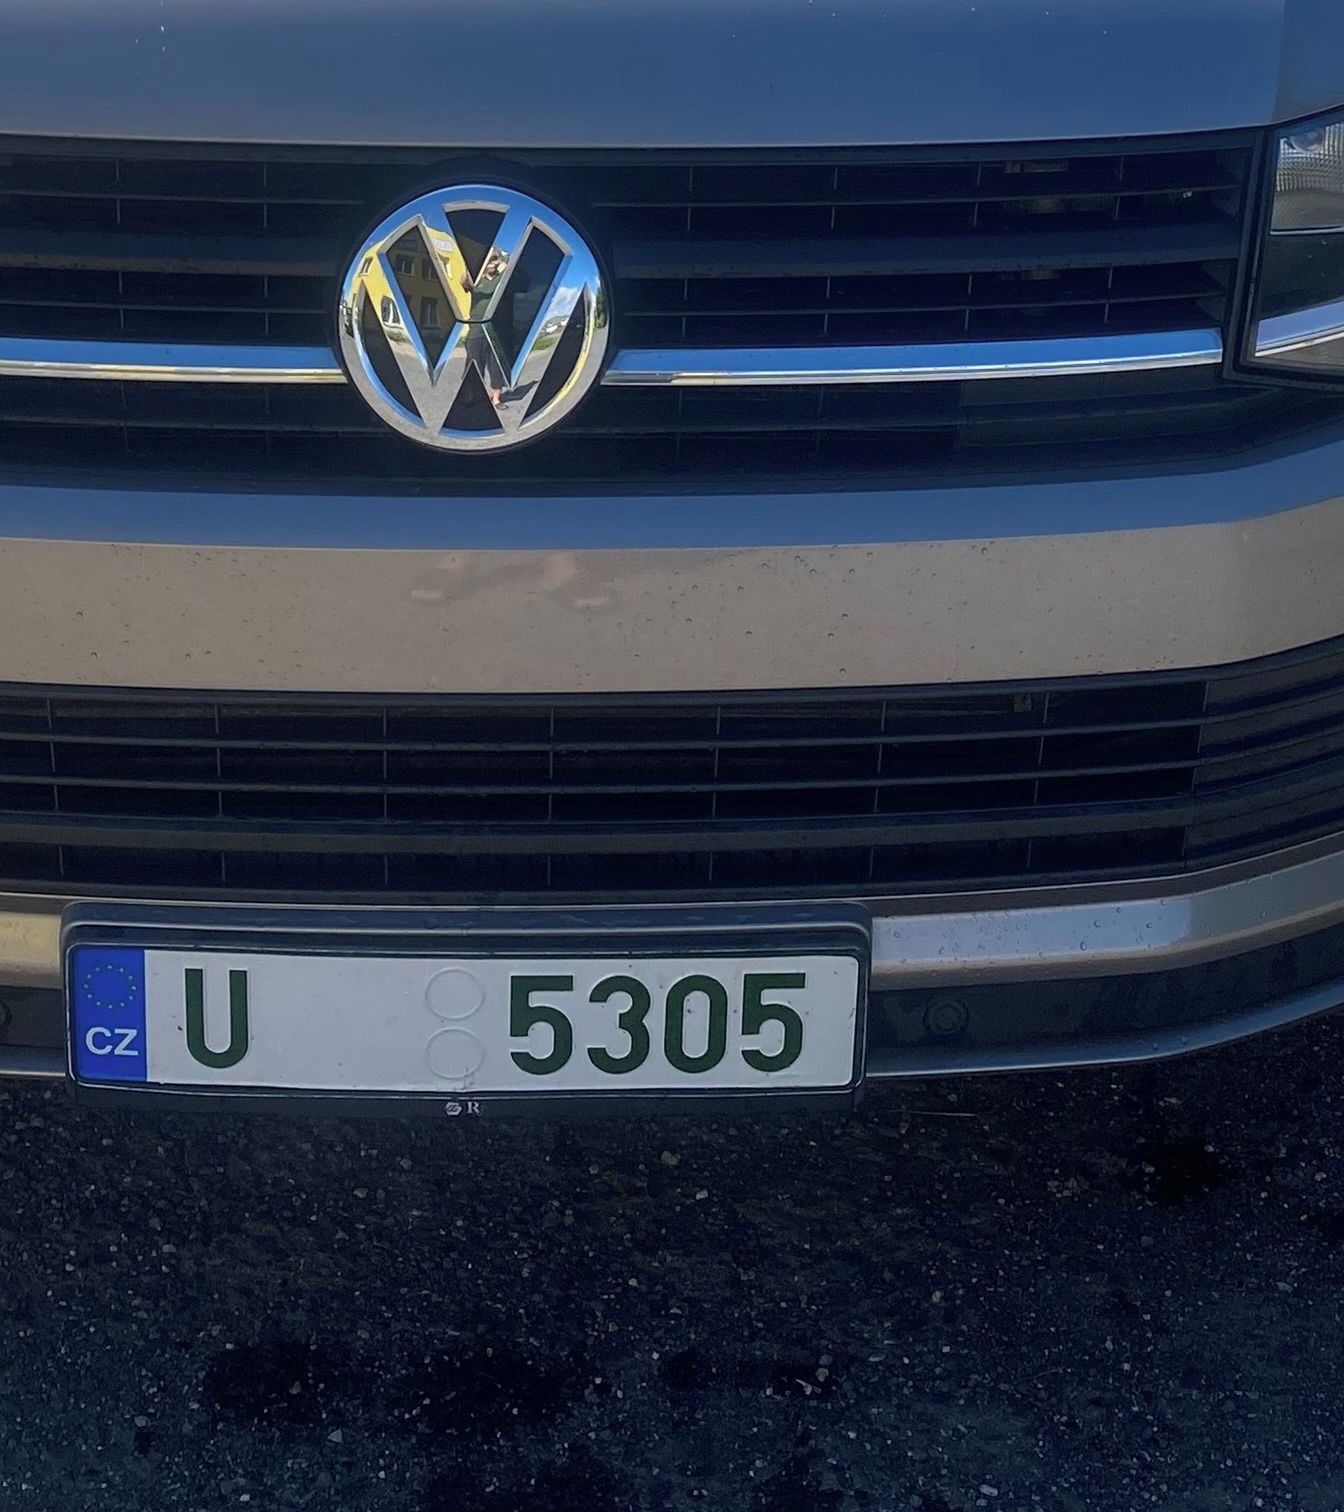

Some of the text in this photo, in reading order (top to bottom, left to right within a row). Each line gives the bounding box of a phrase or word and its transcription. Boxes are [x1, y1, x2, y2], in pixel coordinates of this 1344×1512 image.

[86, 1027, 138, 1056] CZ
[185, 968, 806, 1075] U 5305
